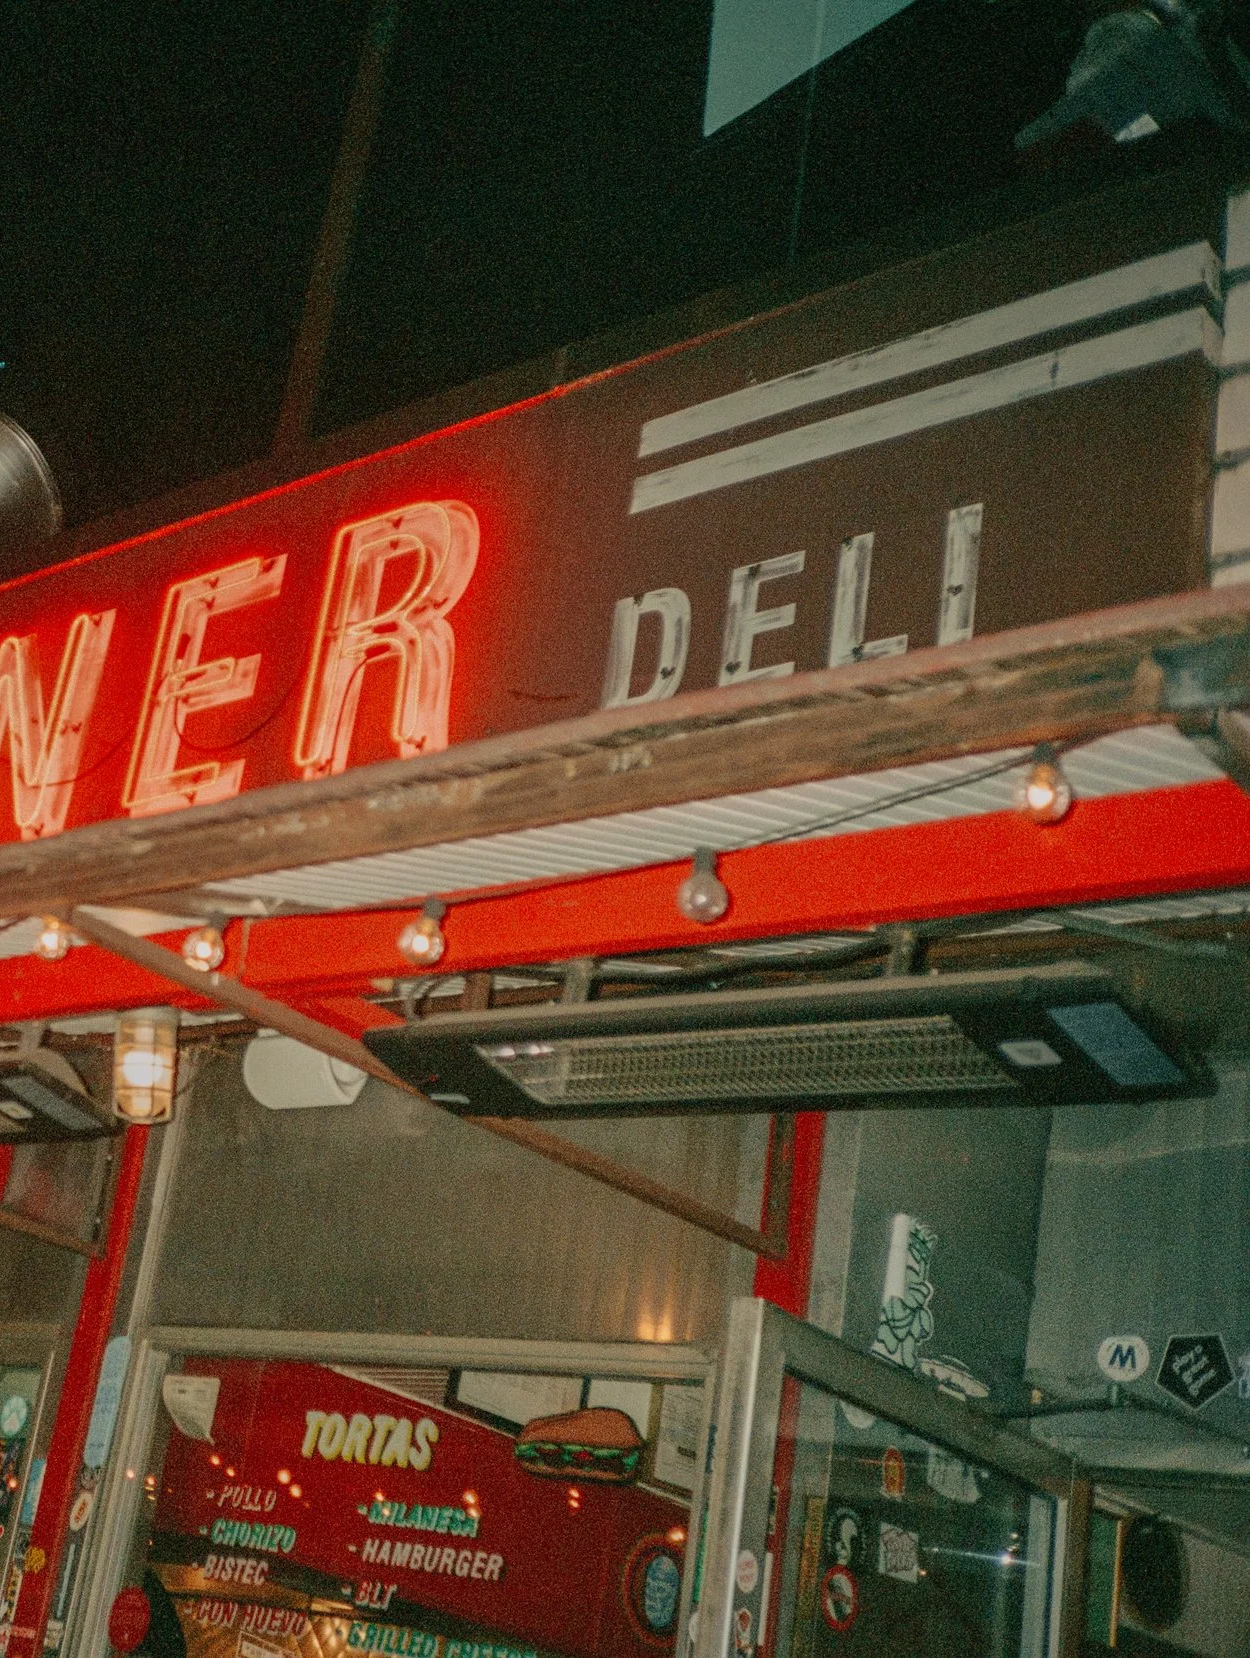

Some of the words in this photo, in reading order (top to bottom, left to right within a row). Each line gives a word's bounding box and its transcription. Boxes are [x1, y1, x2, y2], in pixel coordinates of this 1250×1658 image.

[601, 503, 983, 708] DELI
[301, 1410, 439, 1472] TORTAS
[217, 1484, 278, 1512] POLLO
[211, 1519, 296, 1553] CHORIZO
[368, 1501, 478, 1537] MILANESA
[204, 1553, 269, 1585] BISTEC
[362, 1539, 504, 1582] HAMBURGER
[355, 1581, 397, 1610] BLT
[198, 1598, 239, 1628] CON
[240, 1602, 309, 1639] HUEVO
[347, 1620, 439, 1658] GRILLED
[445, 1638, 538, 1658] CHEE
